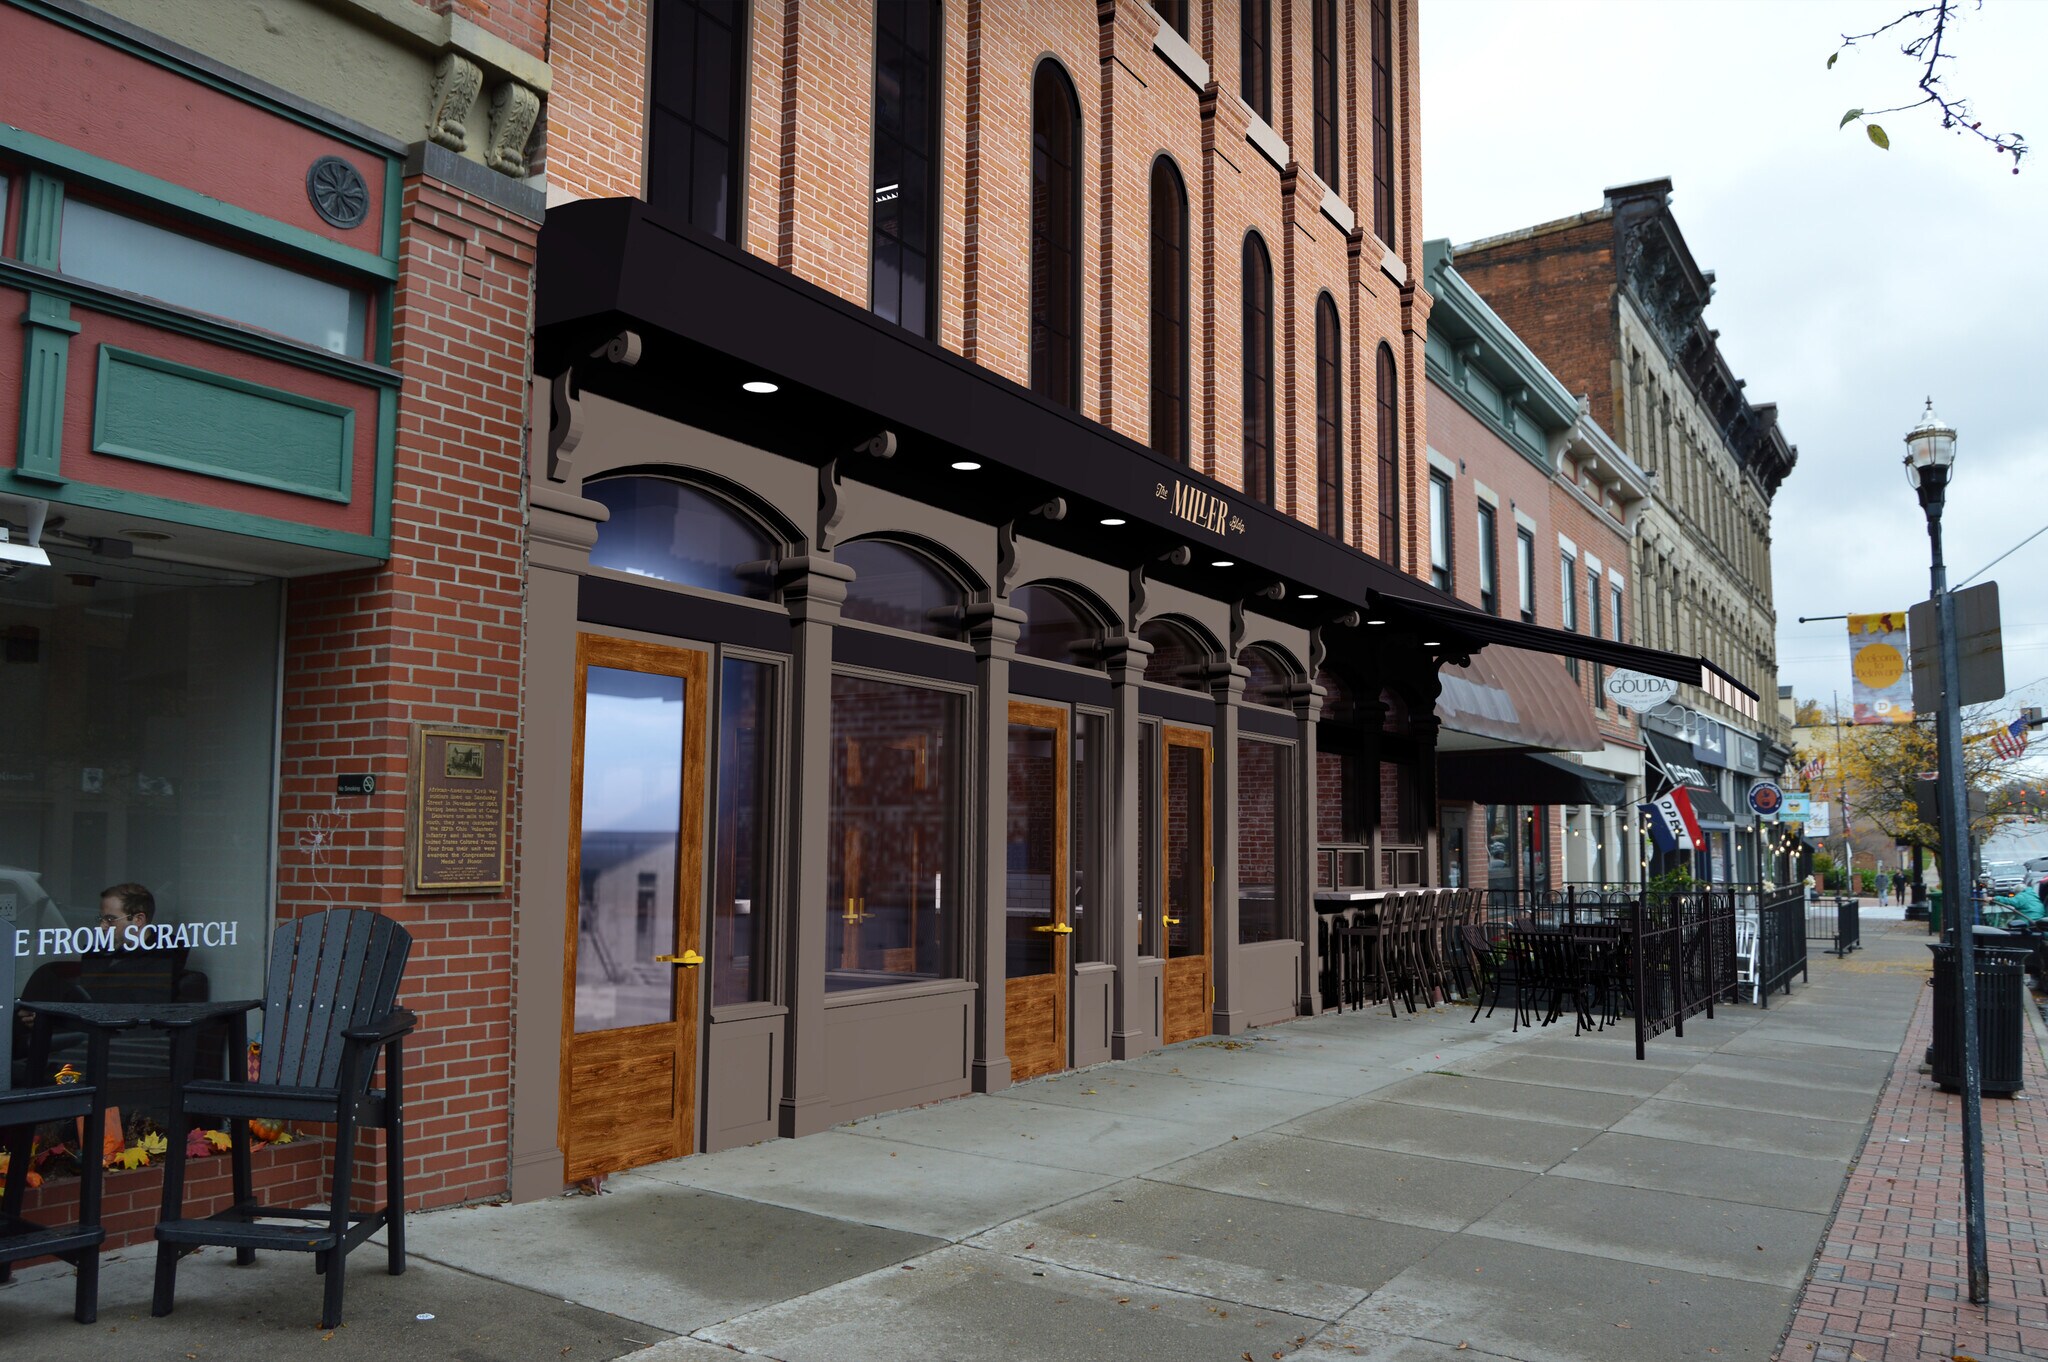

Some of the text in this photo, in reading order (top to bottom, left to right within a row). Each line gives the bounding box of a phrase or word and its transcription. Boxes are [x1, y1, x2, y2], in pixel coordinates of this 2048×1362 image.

[1155, 482, 1168, 500] The
[1169, 479, 1229, 536] MILLER
[1856, 653, 1901, 663] Welcome
[1609, 679, 1671, 694] GOUDA
[1661, 801, 1685, 838] OPEN
[38, 926, 116, 955] FROM
[123, 921, 238, 952] SCRATCH
